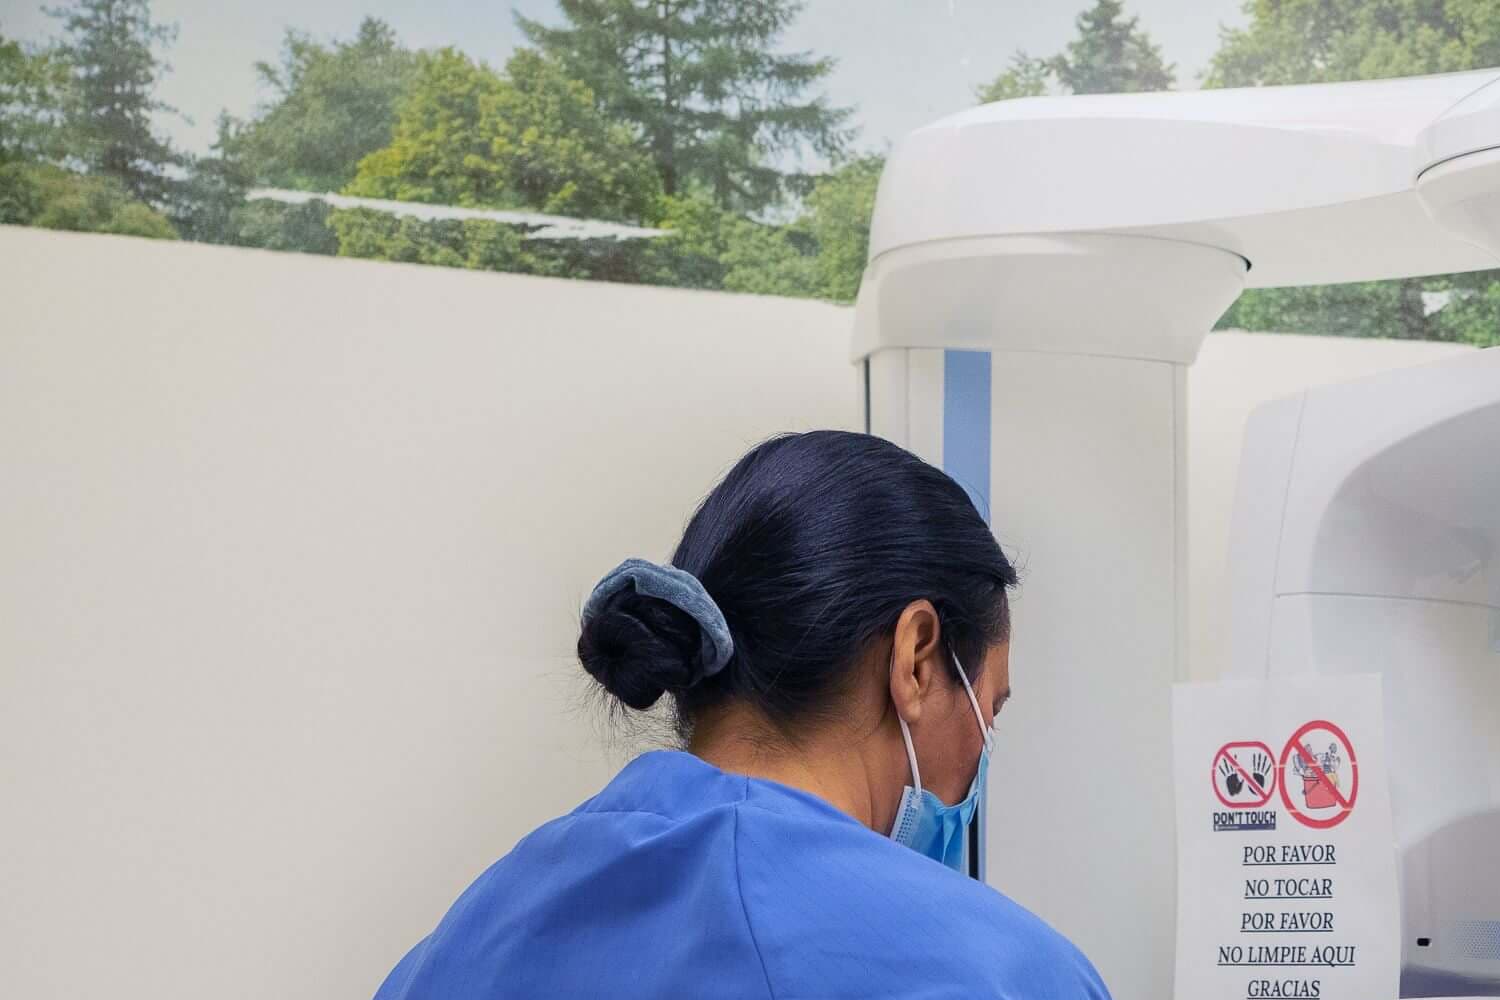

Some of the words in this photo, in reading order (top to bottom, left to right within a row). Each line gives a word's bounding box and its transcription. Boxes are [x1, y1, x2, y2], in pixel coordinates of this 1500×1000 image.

[1213, 812, 1243, 825] DON'T
[1245, 811, 1276, 825] TOUCH
[1243, 846, 1276, 863] POR
[1281, 845, 1336, 863] FAVOR
[1245, 880, 1269, 896] NO
[1274, 879, 1332, 896] TOCAR
[1241, 913, 1275, 930] POR
[1280, 913, 1333, 930] FAVOR
[1218, 947, 1243, 964] NO
[1248, 946, 1306, 963] LIMPIE
[1311, 946, 1355, 967] AQUI
[1247, 981, 1321, 998] GRACIAS
